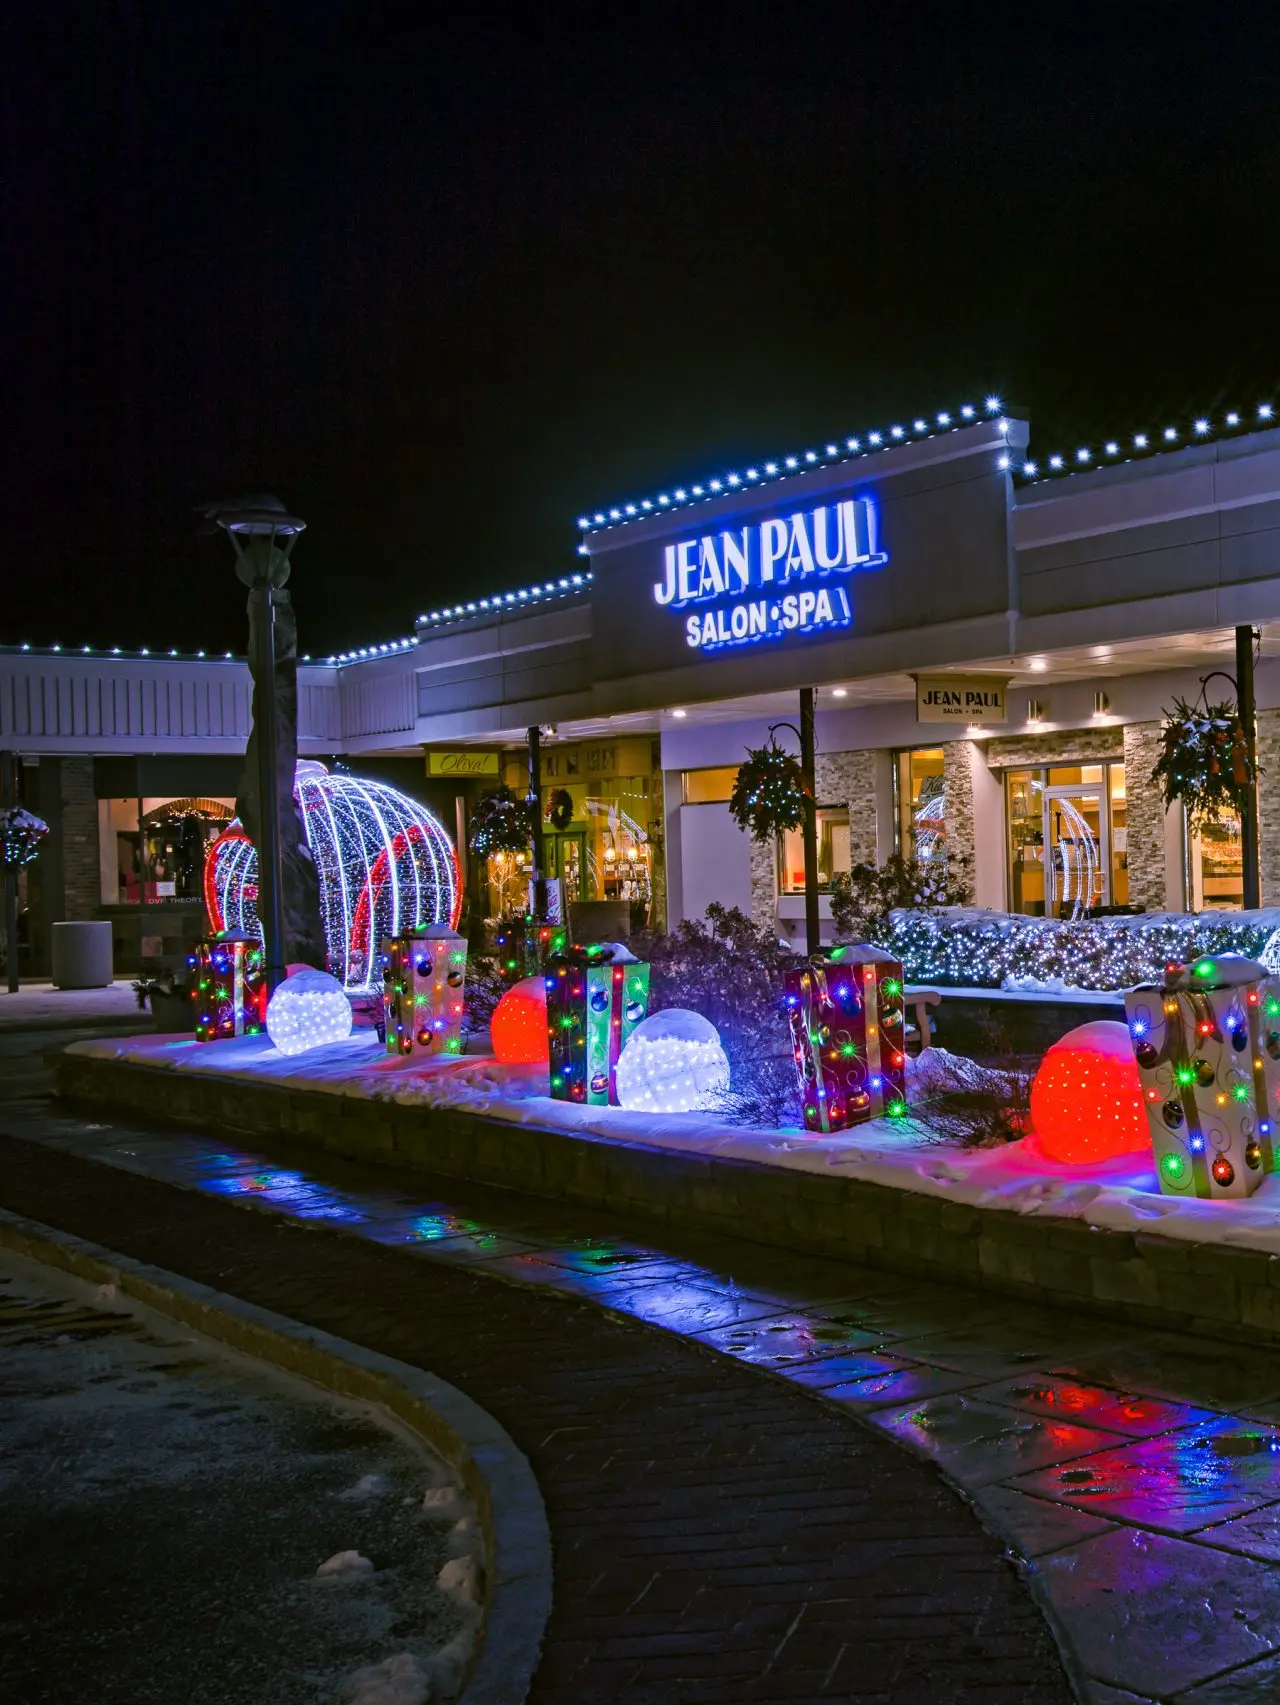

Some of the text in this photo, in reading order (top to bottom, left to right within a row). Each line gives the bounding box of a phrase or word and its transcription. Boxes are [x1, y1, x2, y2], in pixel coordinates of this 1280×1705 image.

[653, 499, 871, 606] JEAN PAUL
[686, 588, 834, 648] SALON SPA
[923, 690, 1002, 707] JEAN PAUL
[943, 707, 962, 715] SALON
